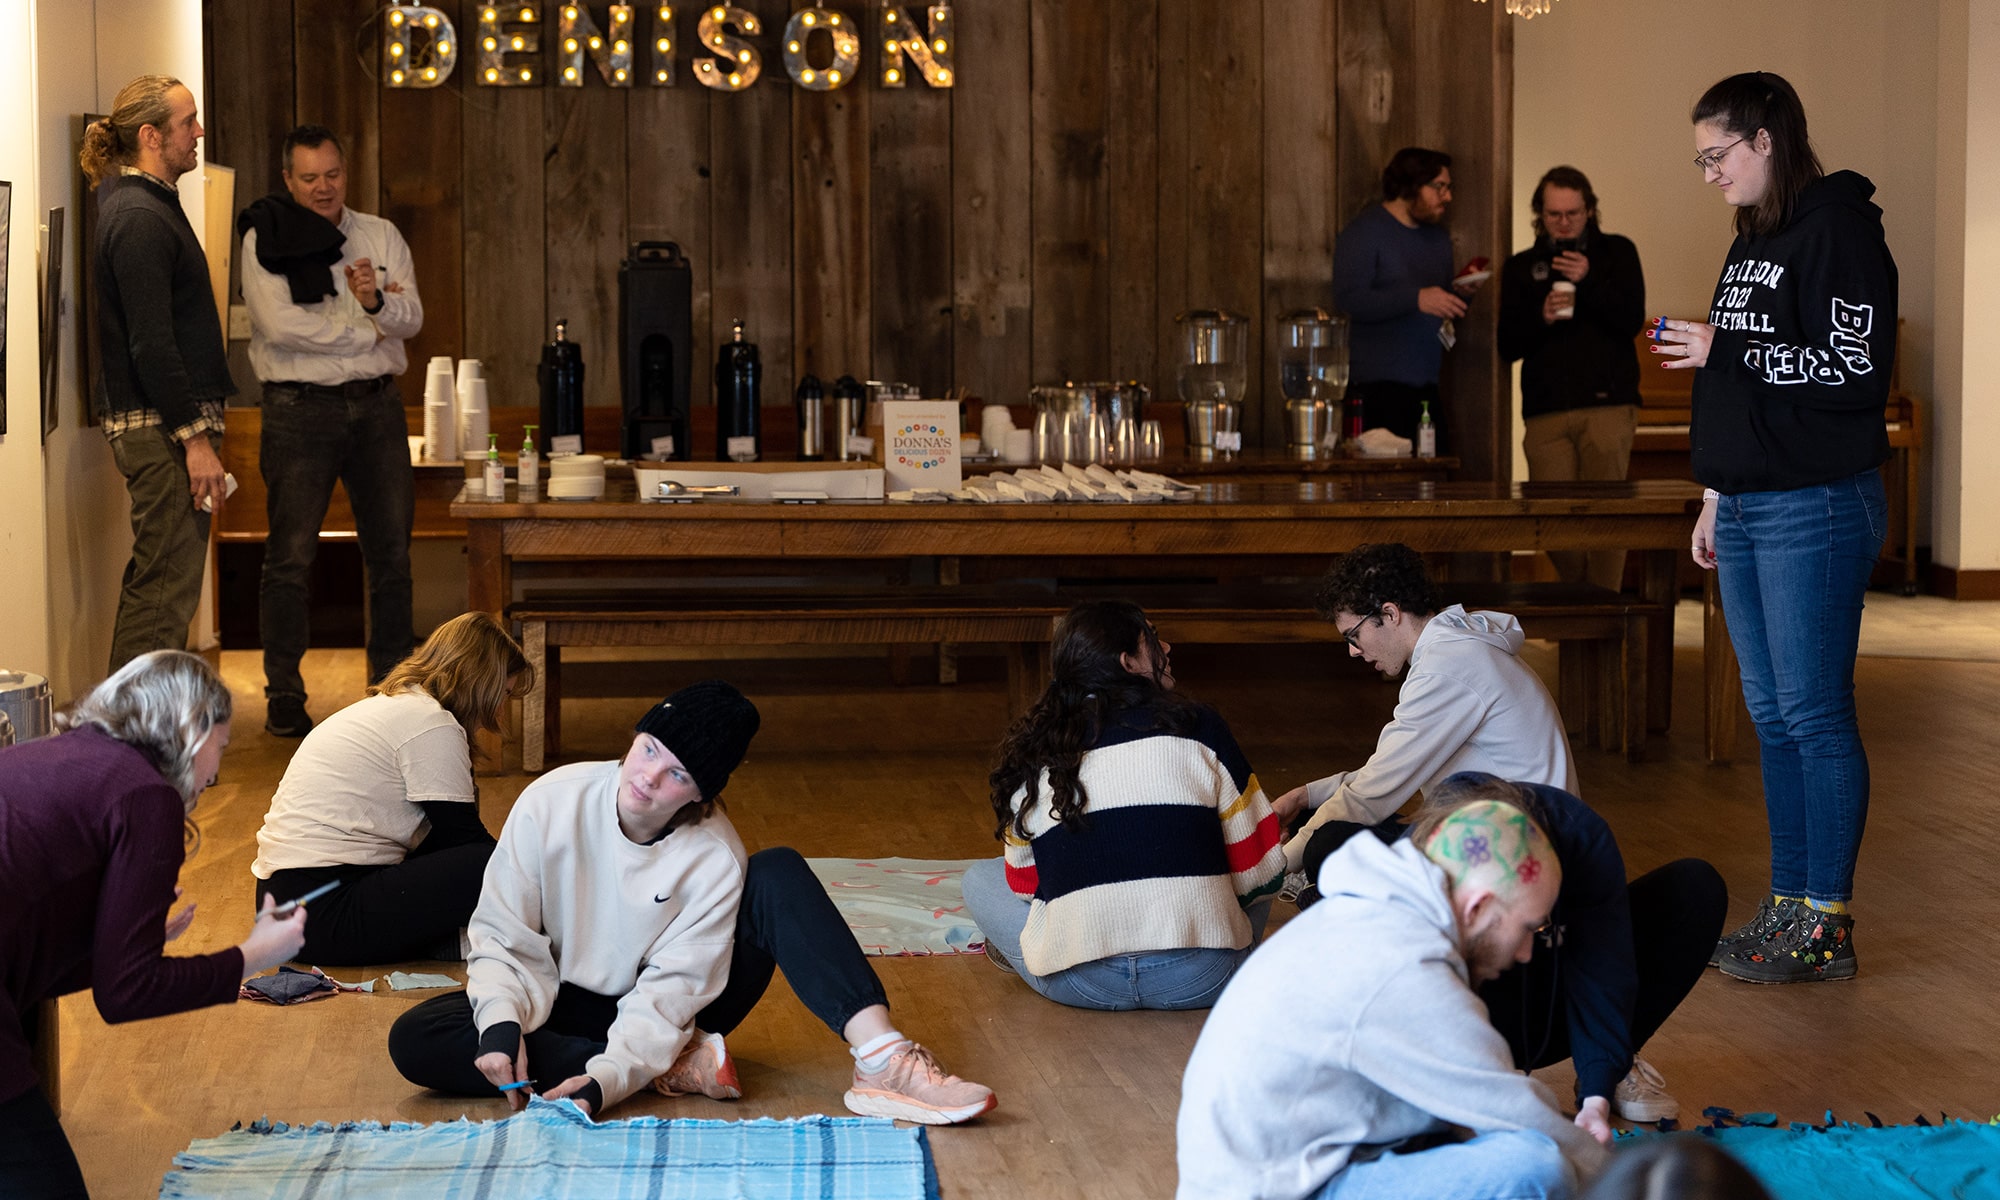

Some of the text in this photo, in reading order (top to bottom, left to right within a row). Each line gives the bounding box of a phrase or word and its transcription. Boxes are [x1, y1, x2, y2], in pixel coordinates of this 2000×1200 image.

[384, 4, 954, 91] DENISON
[1716, 286, 1753, 309] 2023
[893, 437, 952, 448] DONNA'S
